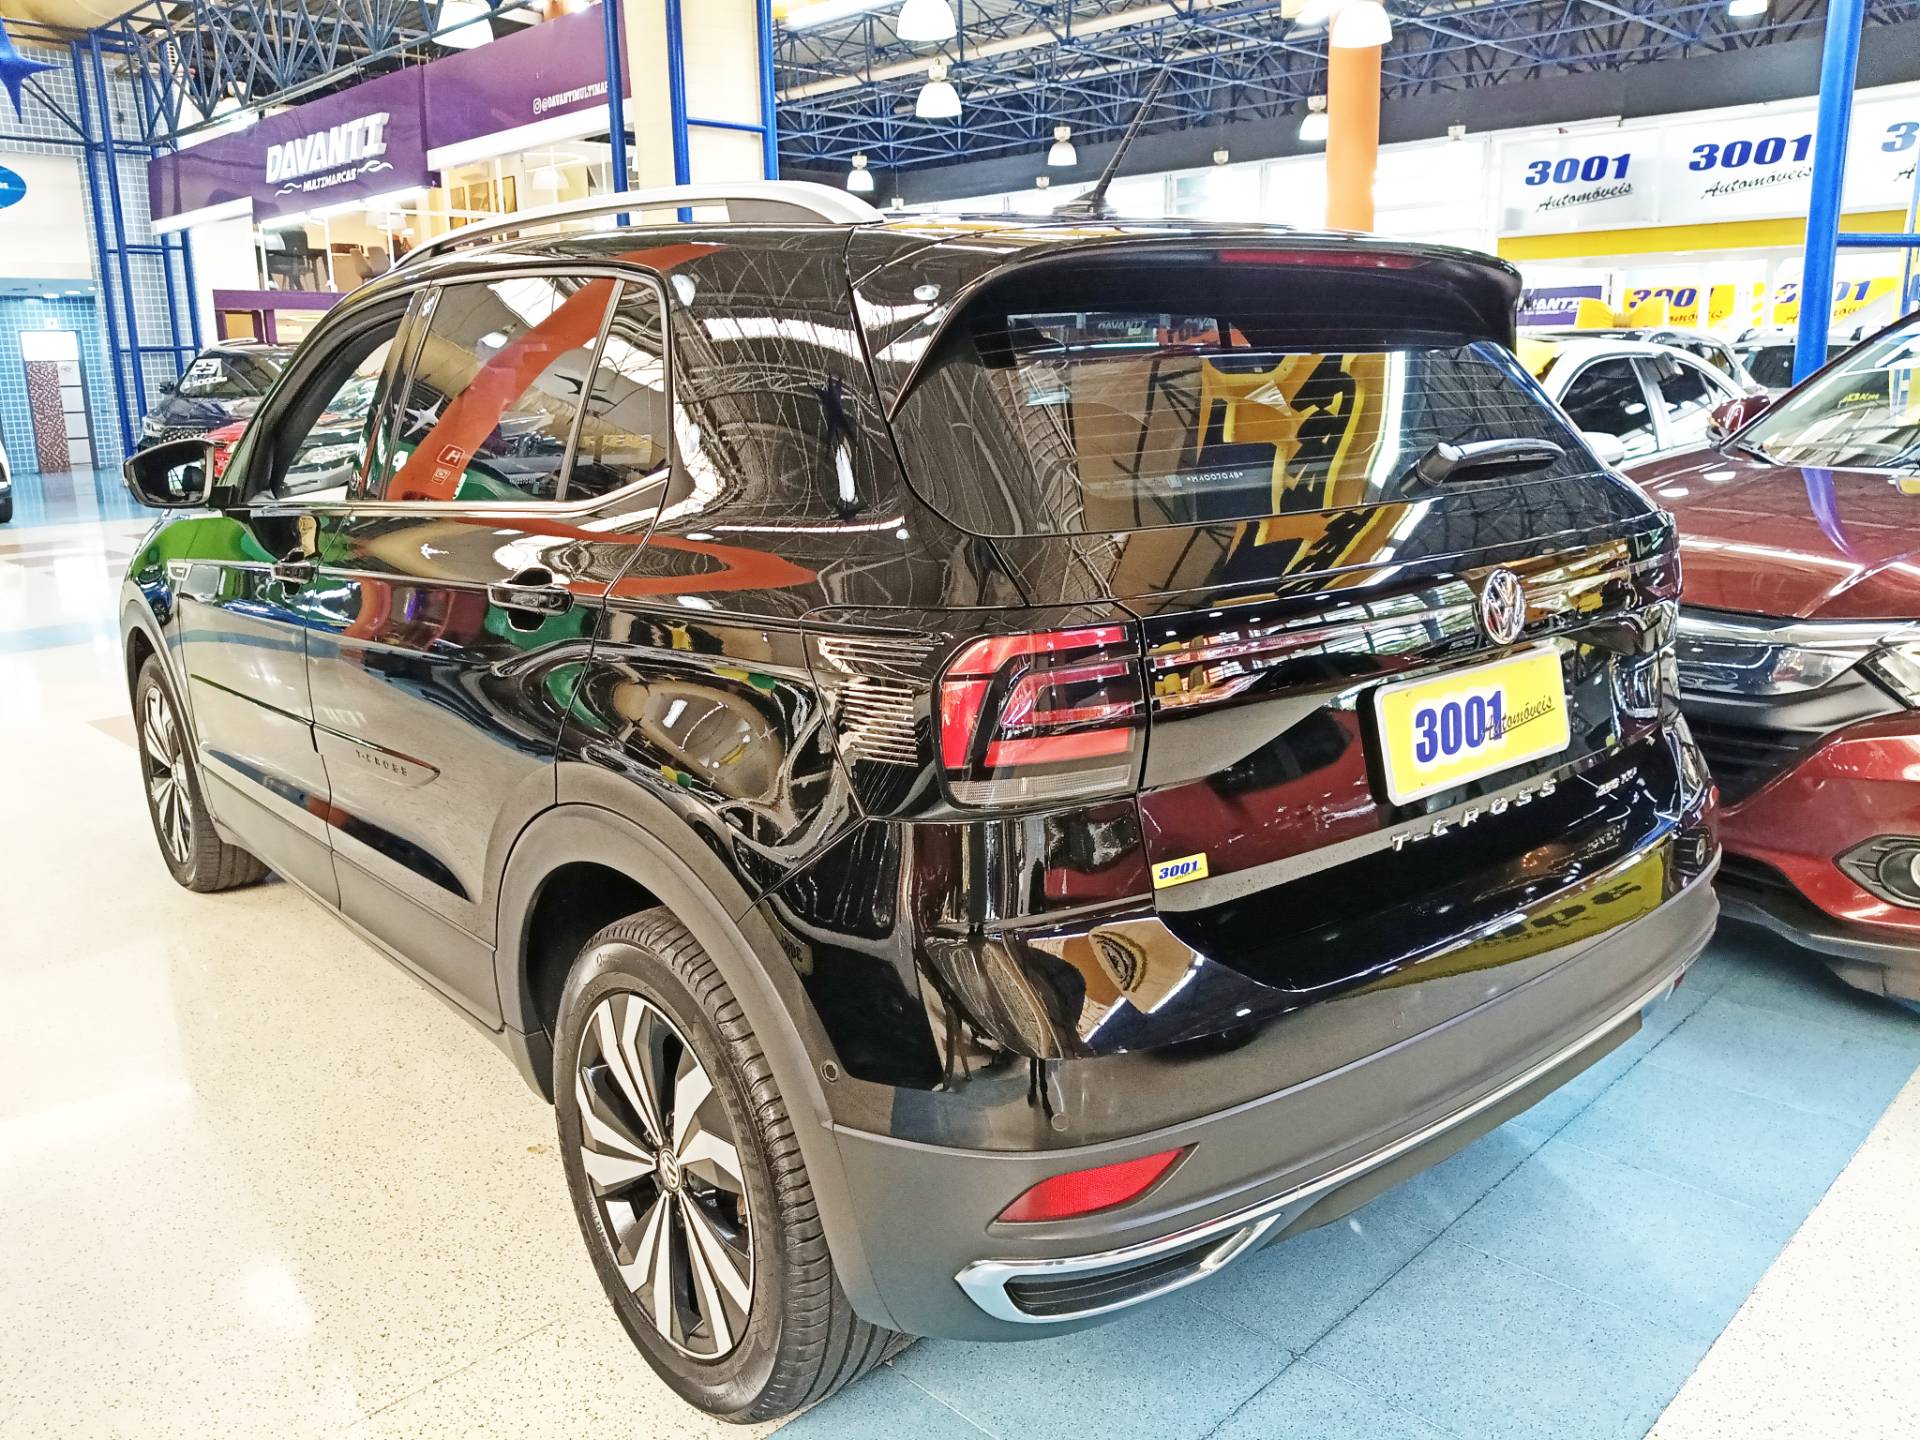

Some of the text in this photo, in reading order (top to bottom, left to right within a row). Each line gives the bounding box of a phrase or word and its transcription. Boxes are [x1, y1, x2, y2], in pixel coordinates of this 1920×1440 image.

[266, 112, 390, 184] DAVANTI
[1688, 134, 1812, 171] 3001
[303, 168, 357, 192] MULTIMARCAS
[1525, 153, 1631, 186] 3001
[1700, 166, 1812, 199] Automóveis
[1536, 182, 1633, 212] Automóveis
[1415, 690, 1556, 763] 3001 Automóveis
[1391, 777, 1557, 852] T-CROSS
[1159, 860, 1198, 880] 3001
